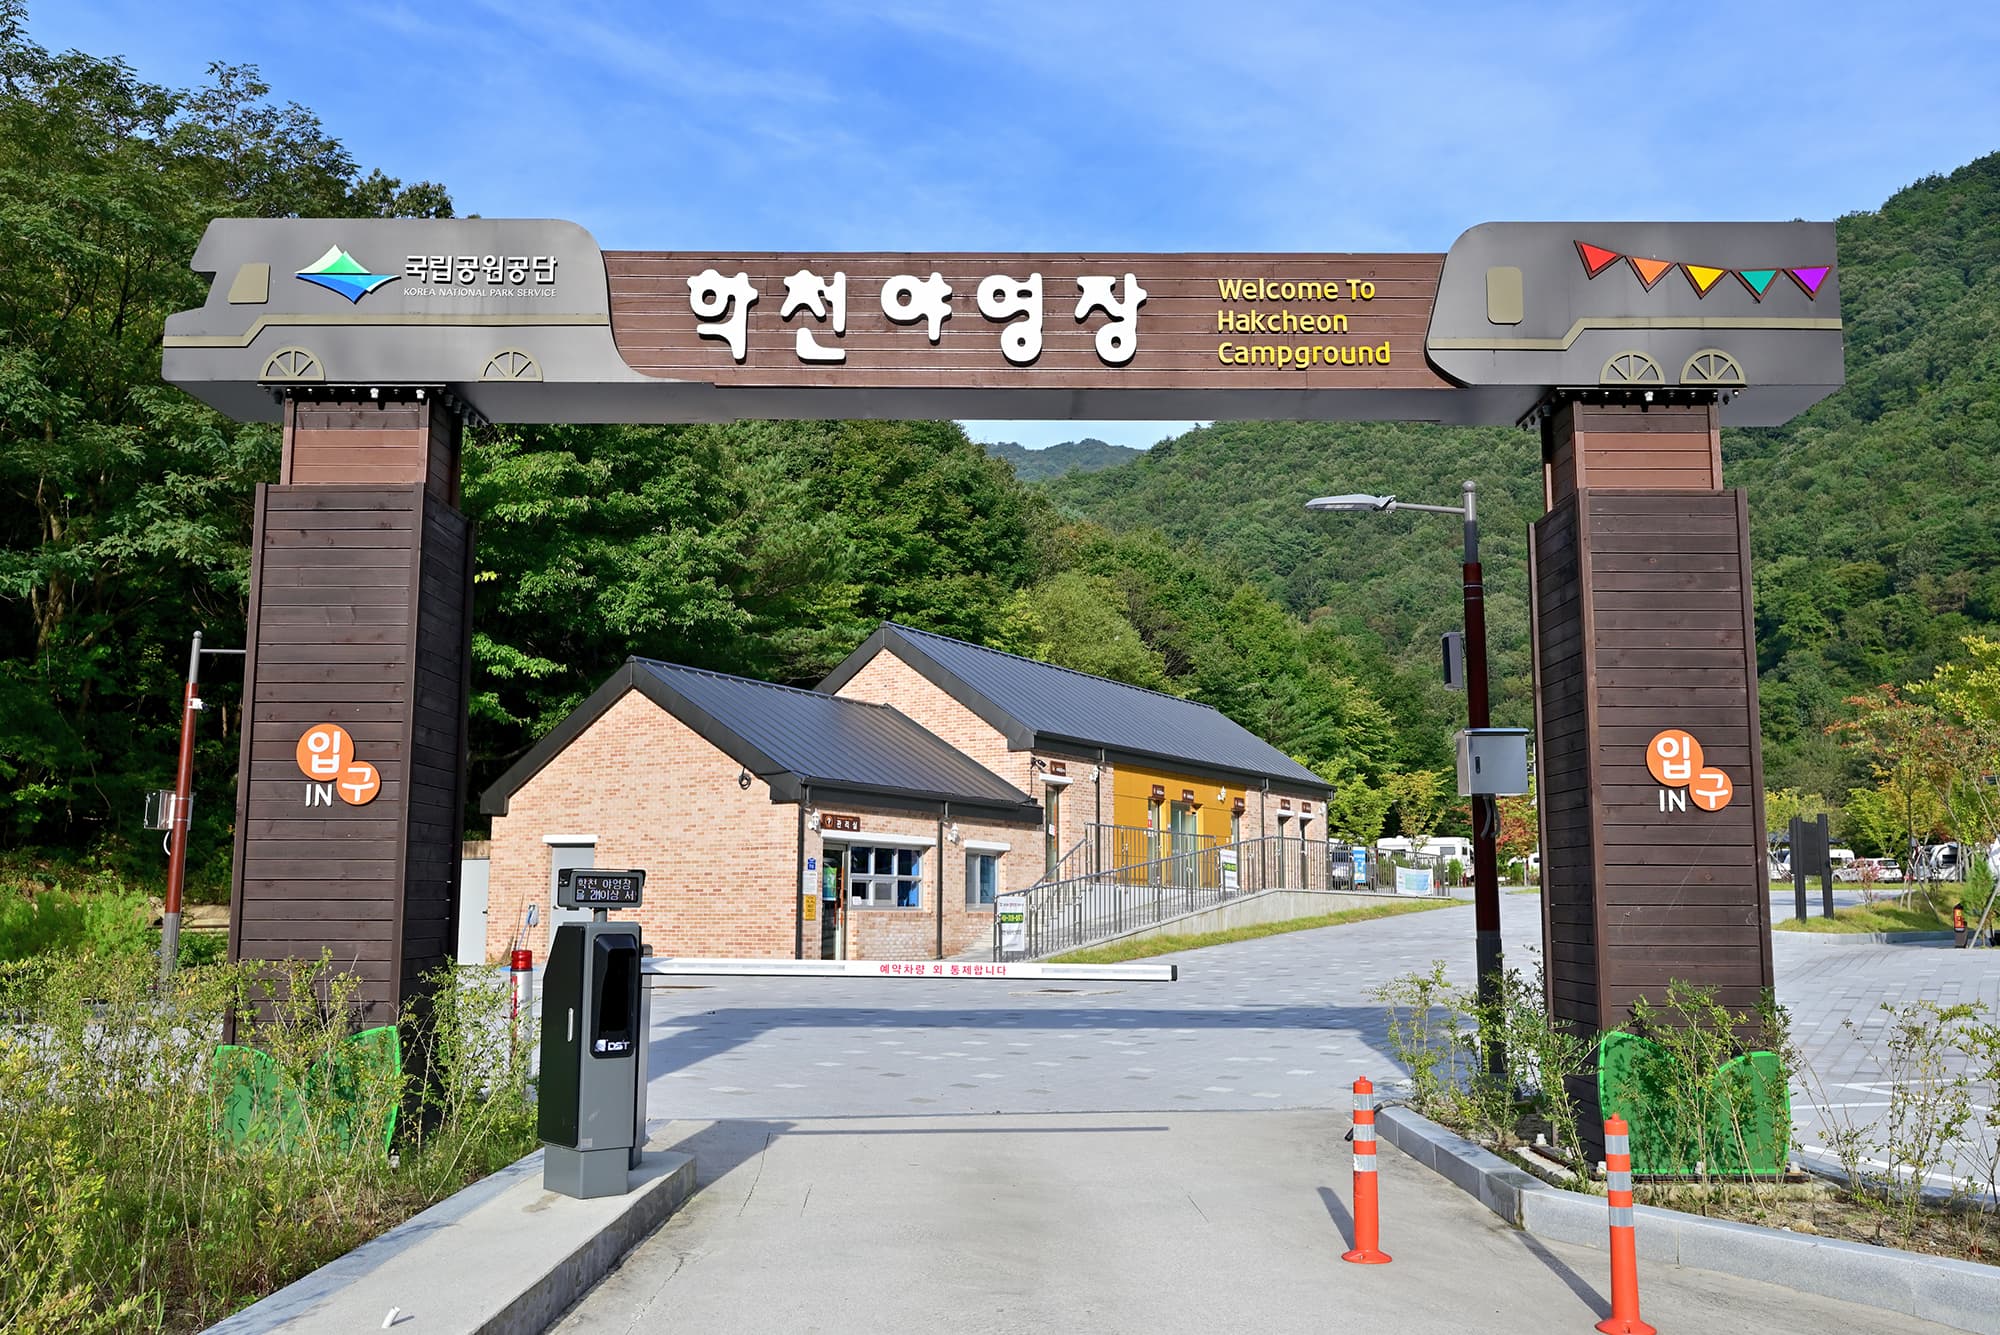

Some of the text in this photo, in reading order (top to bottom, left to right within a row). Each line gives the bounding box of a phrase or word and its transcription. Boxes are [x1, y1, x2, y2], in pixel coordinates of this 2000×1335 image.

[404, 254, 557, 283] 국립공원공단
[403, 288, 557, 297] KOREA NATIONAL PARK SERVICE
[1217, 278, 1376, 300] Welcome To
[1217, 309, 1349, 332] Hakcheon
[1217, 341, 1391, 369] Campground
[305, 784, 332, 806] IN
[1659, 789, 1686, 812] IN
[577, 878, 631, 890] 학천 야영장
[880, 964, 1007, 976] 예약차량 외 통제합니다
